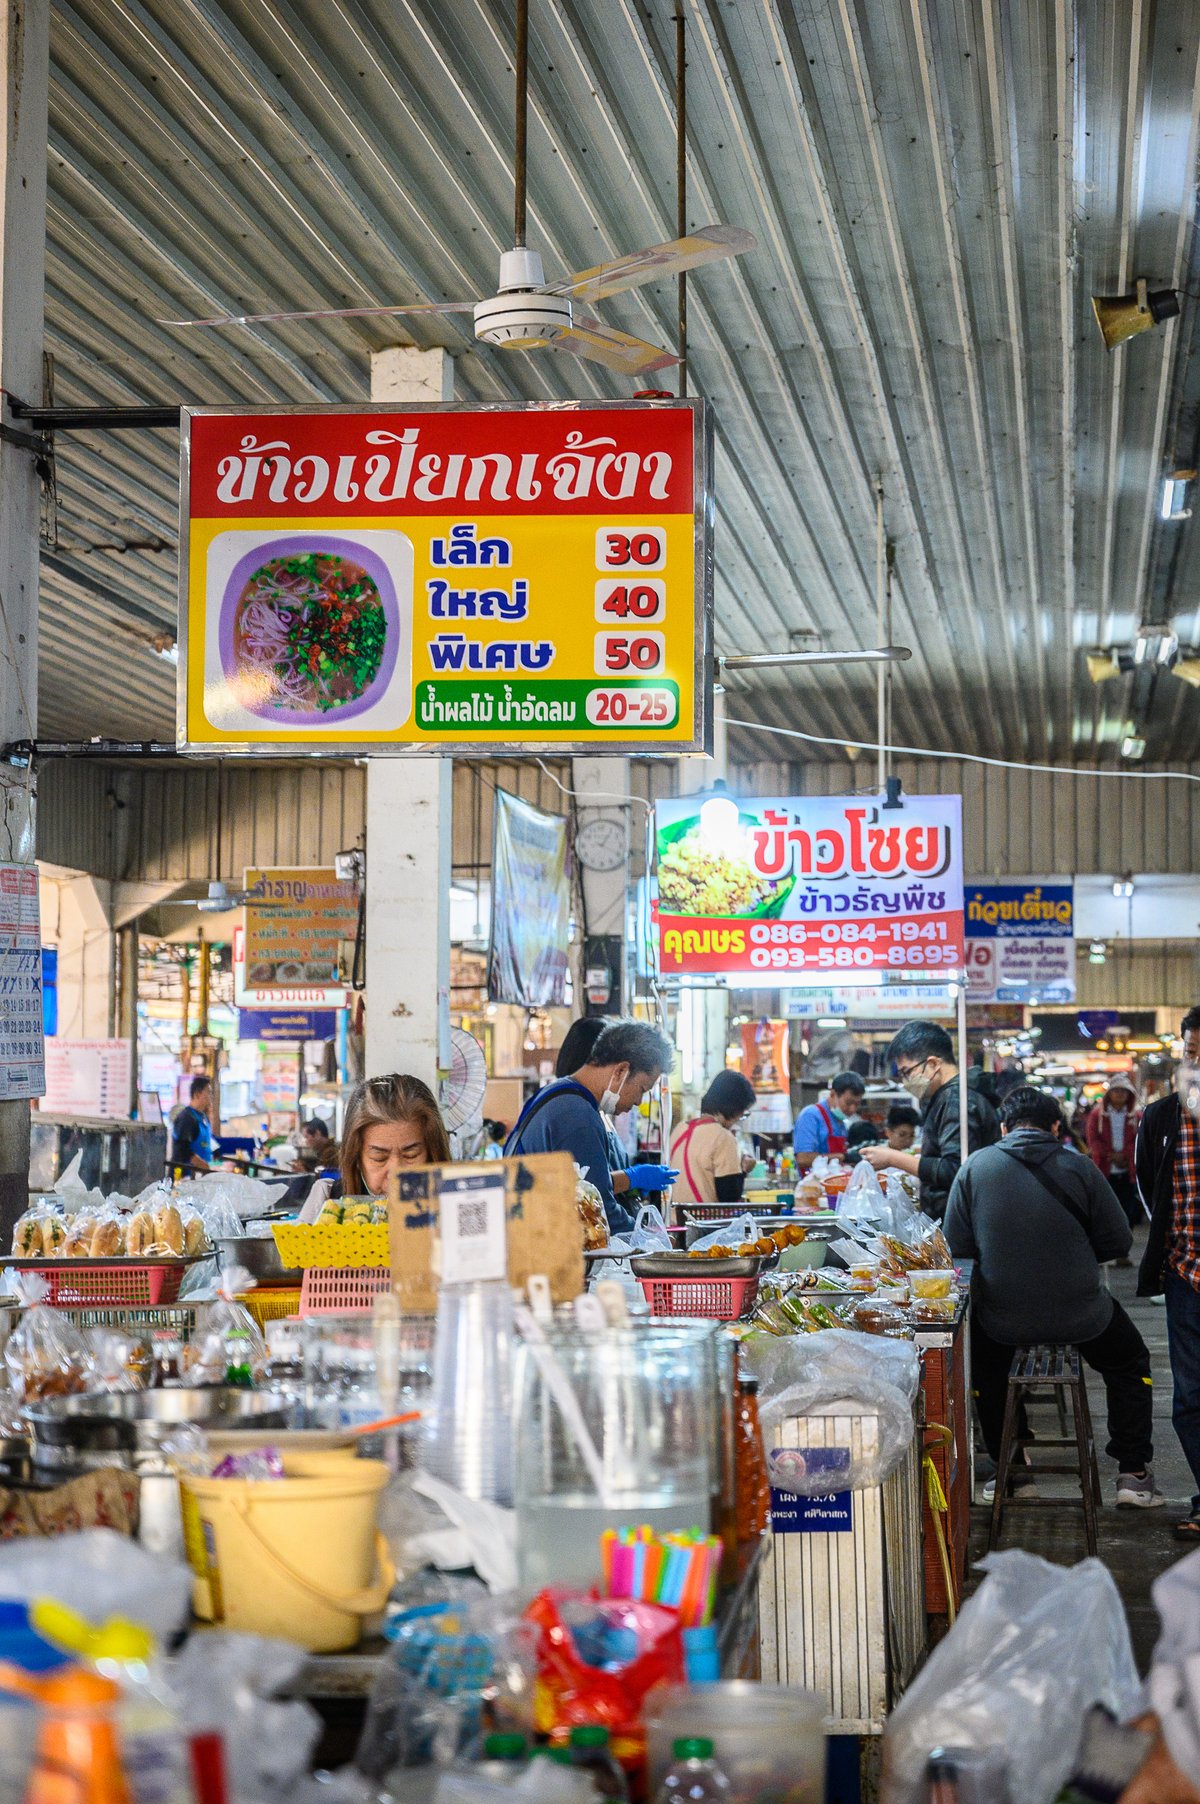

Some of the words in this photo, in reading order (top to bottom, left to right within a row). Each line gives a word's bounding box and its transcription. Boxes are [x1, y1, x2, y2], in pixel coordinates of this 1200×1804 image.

[430, 524, 510, 565] เล็ก
[605, 533, 660, 566] 30
[428, 581, 527, 620] ใหญ่
[602, 586, 659, 618] 40
[429, 635, 553, 670] พิเศษ
[605, 638, 660, 671] 50
[421, 684, 494, 722] น้ำผลไม้
[498, 684, 576, 722] น้ำอัดลม
[595, 692, 668, 722] 20-25
[799, 884, 946, 913] ข้าวธัญพืช
[750, 921, 948, 944] 086-084-1941
[750, 945, 959, 968] 093-580-8695
